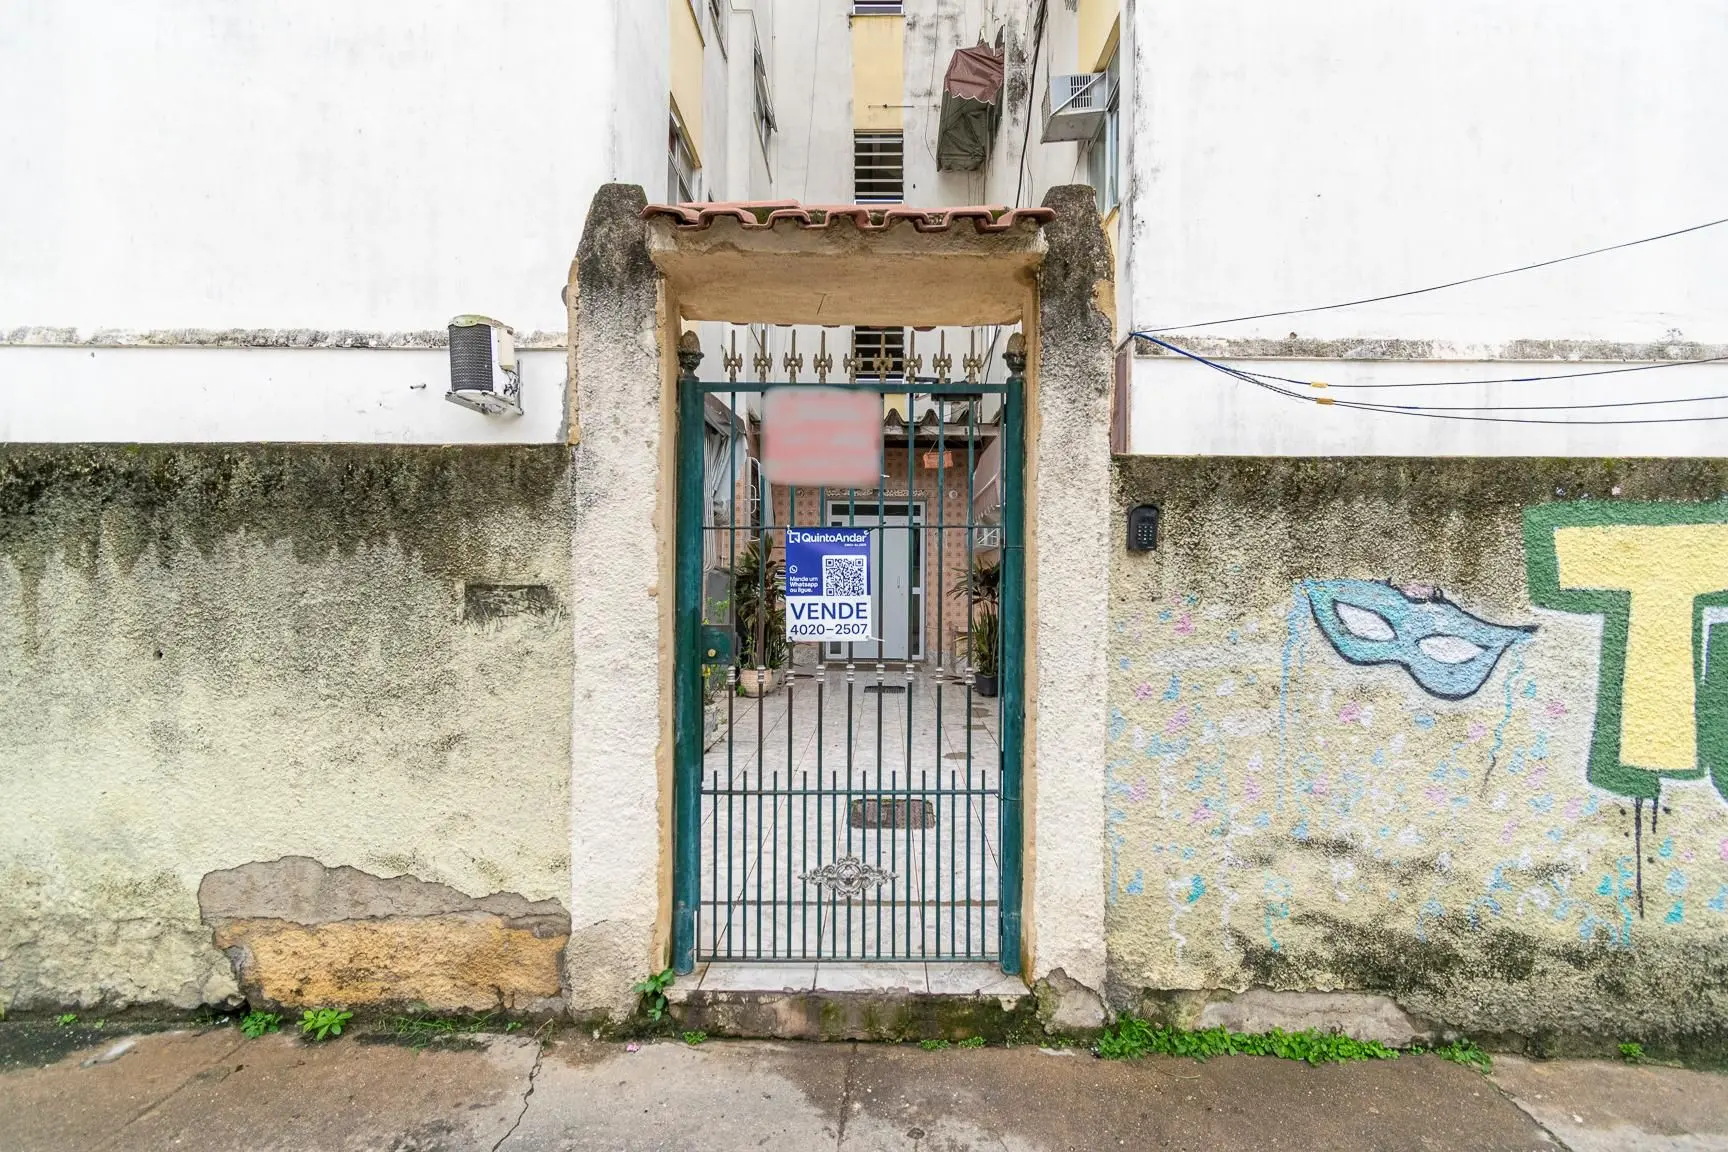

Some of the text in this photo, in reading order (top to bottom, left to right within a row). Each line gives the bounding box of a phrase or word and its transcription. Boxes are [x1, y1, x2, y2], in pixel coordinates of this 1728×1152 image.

[801, 533, 867, 543] QuintoAndar
[790, 602, 868, 620] VENDE
[790, 623, 868, 636] 4020-2507
[1523, 499, 1728, 800] T
